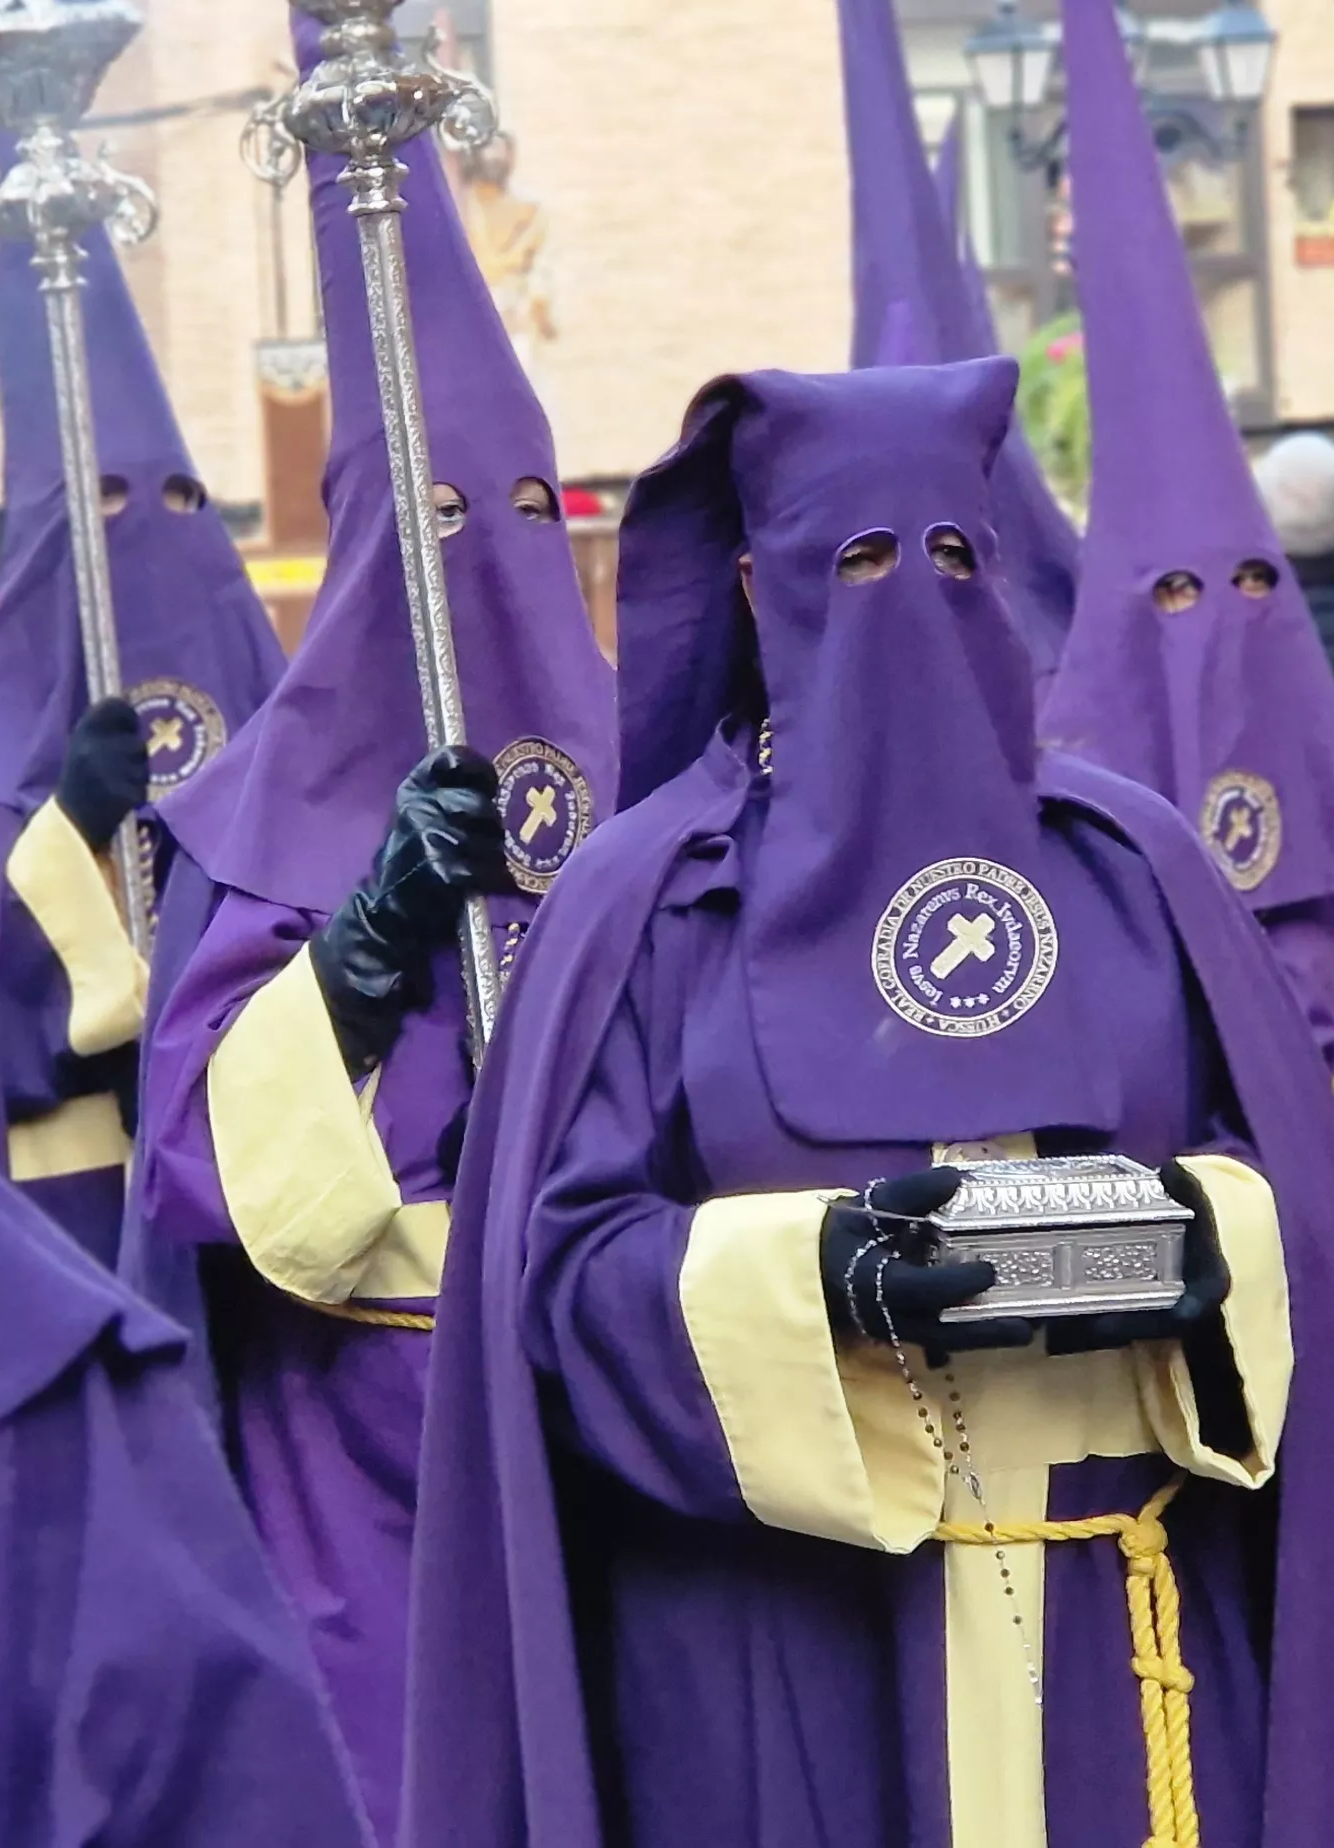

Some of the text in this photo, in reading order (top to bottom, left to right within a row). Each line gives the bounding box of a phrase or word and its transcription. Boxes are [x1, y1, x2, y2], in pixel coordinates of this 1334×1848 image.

[909, 862, 976, 896] NUESTRO
[978, 863, 1025, 894] PADRE
[894, 890, 915, 912] DE
[965, 883, 998, 914] Rex
[1021, 888, 1051, 929] JESUS
[1013, 931, 1054, 1010] NAZARENO
[890, 989, 927, 1022] REAL
[939, 1014, 1002, 1033] HUESCA
